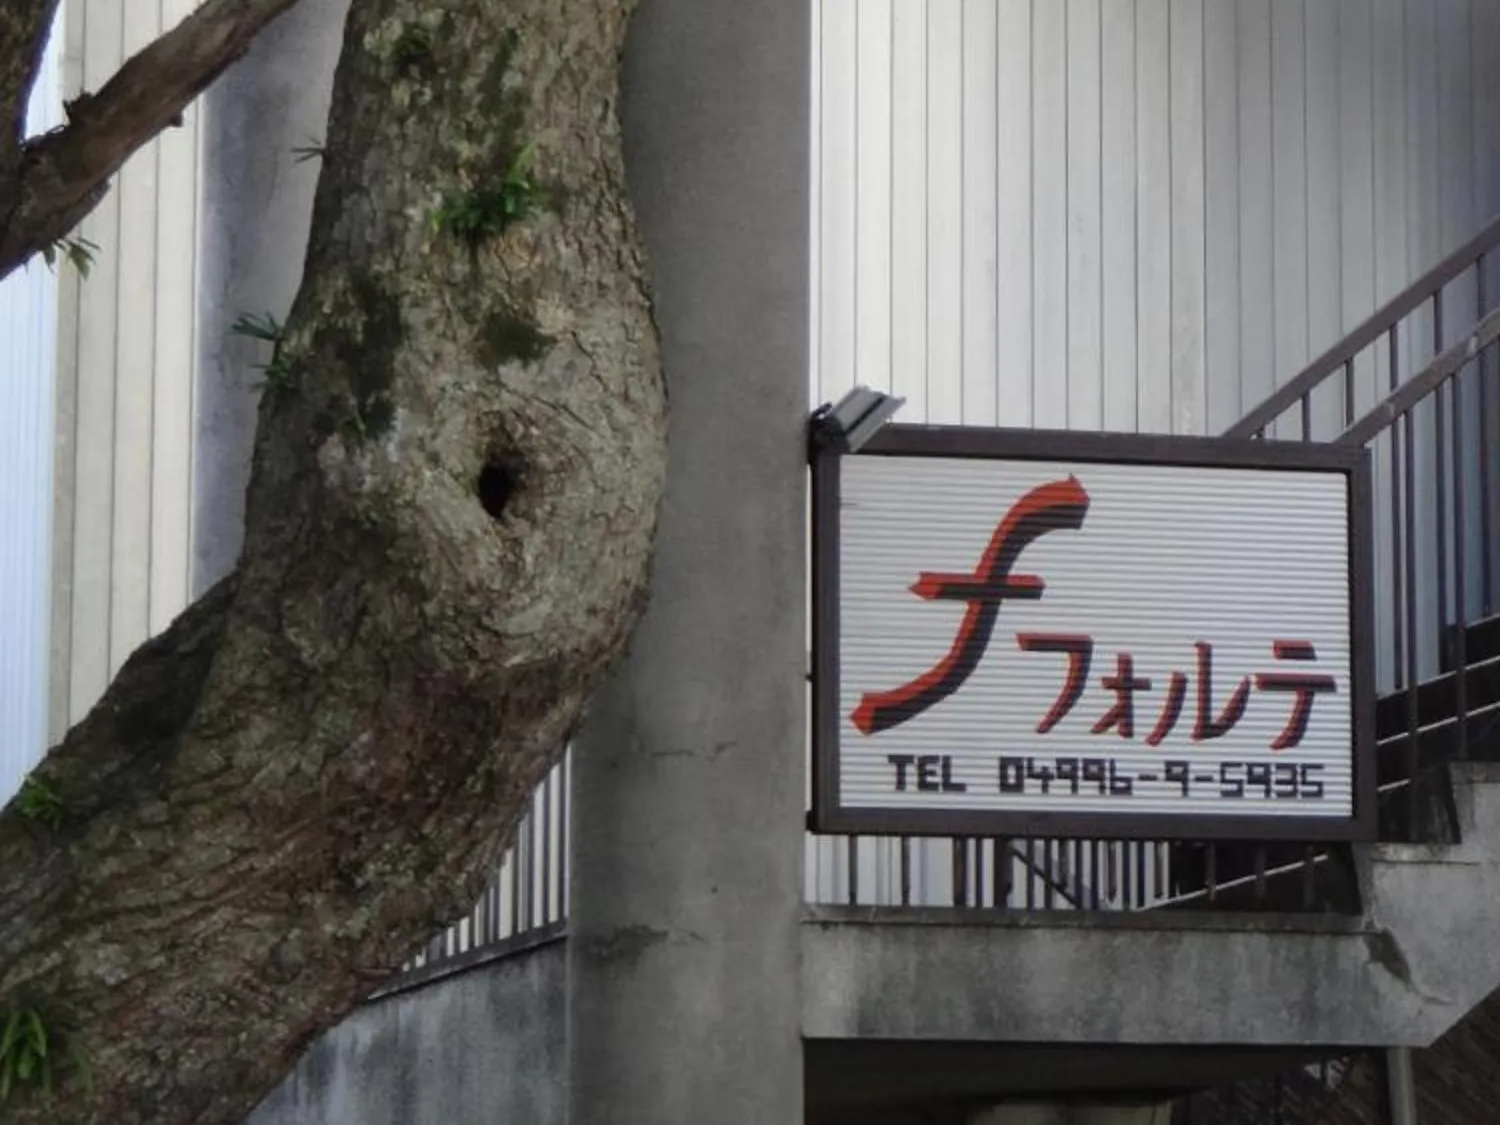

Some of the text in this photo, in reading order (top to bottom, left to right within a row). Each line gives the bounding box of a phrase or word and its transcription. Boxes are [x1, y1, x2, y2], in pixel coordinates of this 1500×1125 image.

[1016, 632, 1337, 751] フォルテ
[887, 754, 1325, 799] TEL 04996-9-5935
